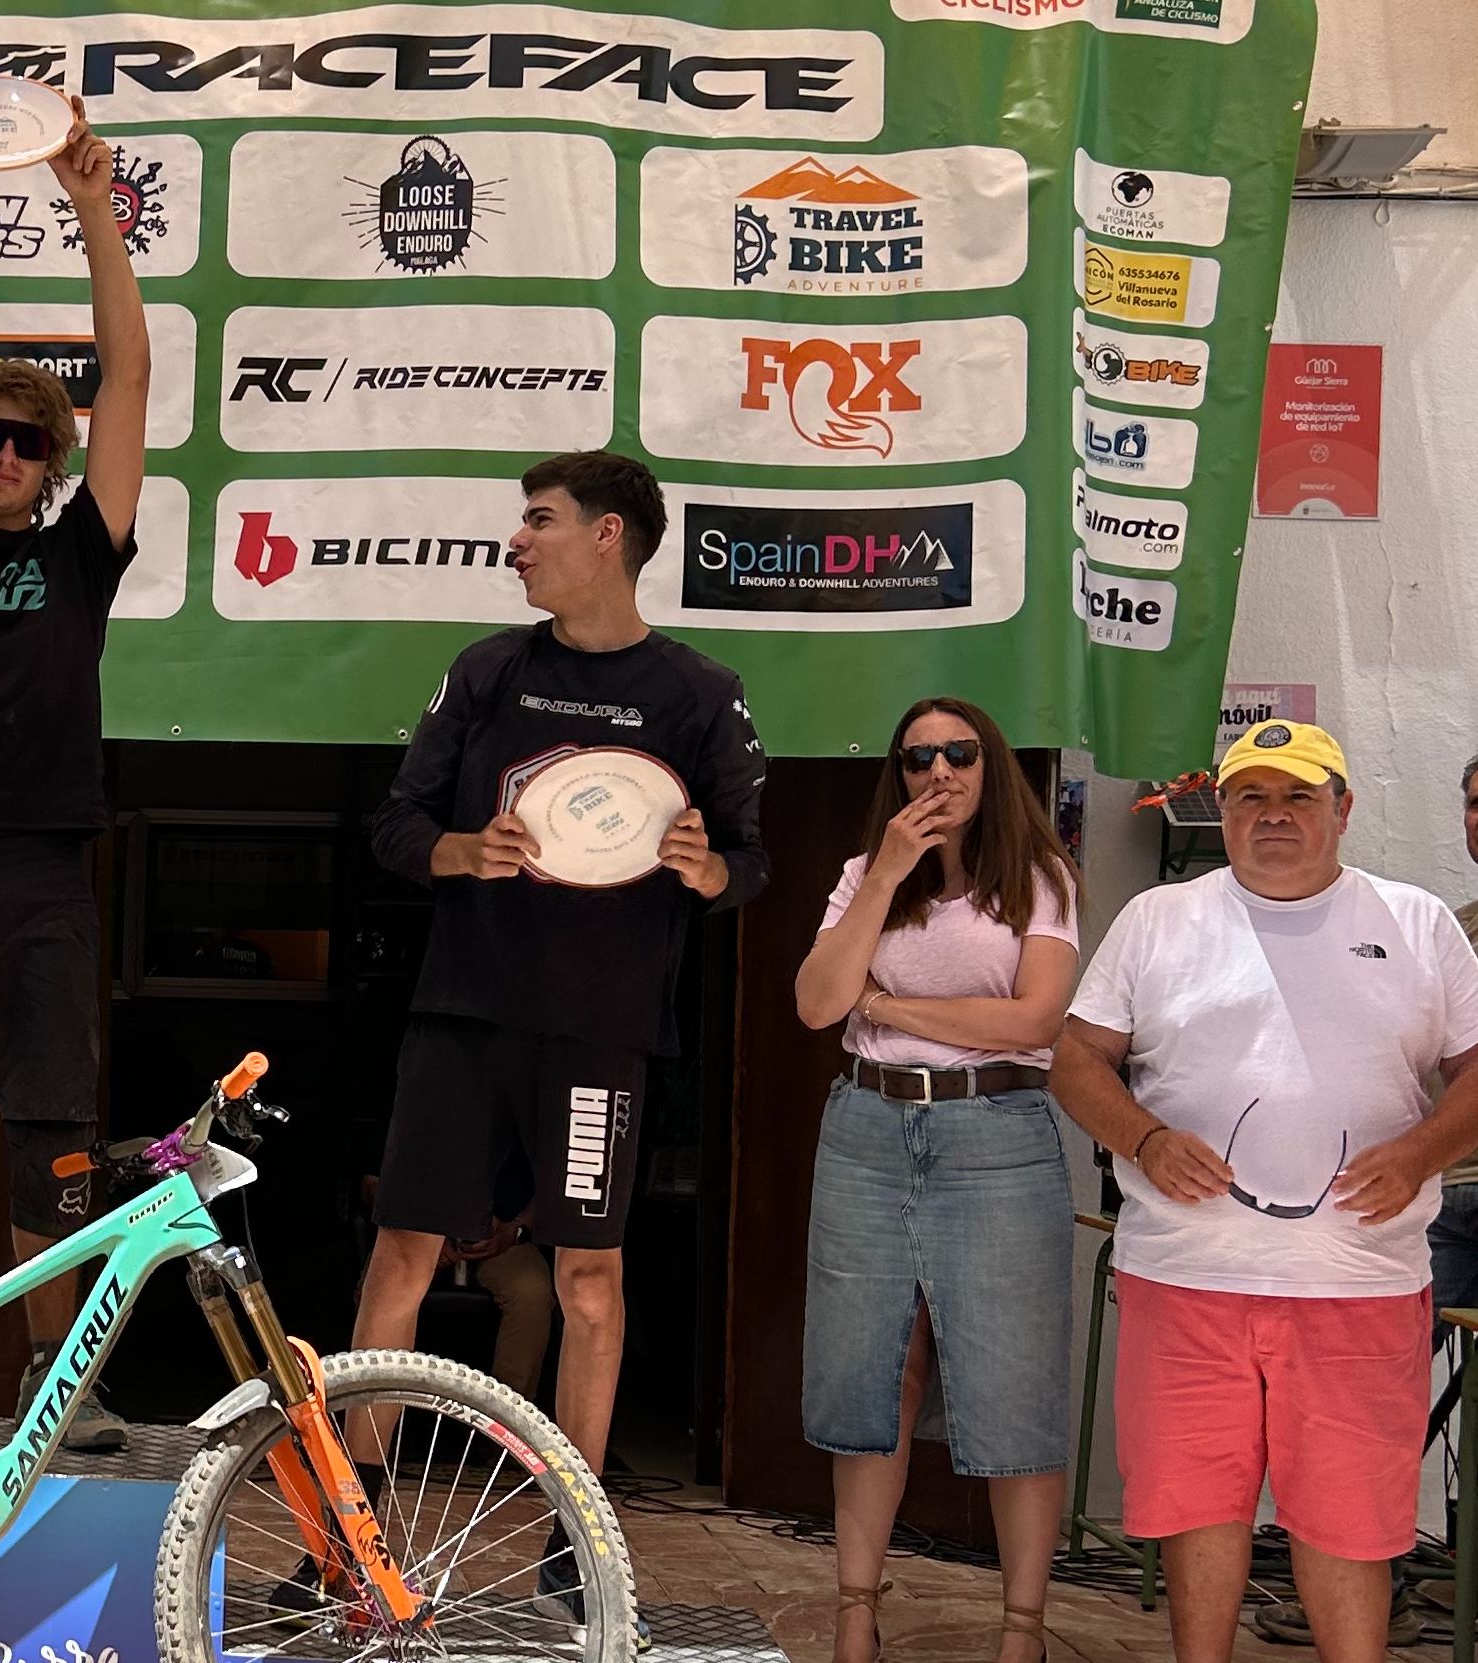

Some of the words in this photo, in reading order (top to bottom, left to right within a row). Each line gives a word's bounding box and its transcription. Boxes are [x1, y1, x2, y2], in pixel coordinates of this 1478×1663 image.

[1168, 9, 1219, 23] CICLISMO
[82, 32, 855, 113] RACEFACE
[398, 184, 455, 208] LOOSE
[384, 210, 468, 233] DOWNHILL
[788, 206, 923, 232] TRAVEL
[1105, 206, 1155, 220] PUERTAS
[396, 233, 454, 254] ENDURO
[1102, 224, 1154, 239] ECOMAN
[787, 235, 923, 274] BIKE
[787, 277, 924, 293] ADVENTURE
[1118, 267, 1181, 281] 635534676
[1118, 281, 1178, 296] Villanueva
[1116, 294, 1131, 305] del
[1133, 295, 1178, 309] Rosario
[228, 356, 329, 402] RC
[740, 337, 922, 430] FOX
[1125, 358, 1202, 387] BIKE
[1280, 411, 1294, 421] de
[1296, 421, 1309, 431] de
[311, 538, 517, 568] BICIM
[698, 529, 901, 585] SpainDH
[739, 576, 787, 588] ENDURO
[788, 579, 797, 587] &
[798, 578, 861, 589] DOWNHILL
[862, 576, 939, 589] ADVENTURES
[520, 694, 644, 720] ENDURA
[565, 1086, 609, 1200] PUMA
[2, 1377, 77, 1508] SANTA
[70, 1273, 130, 1380] CRUZ
[540, 1450, 610, 1556] MAXXIS
